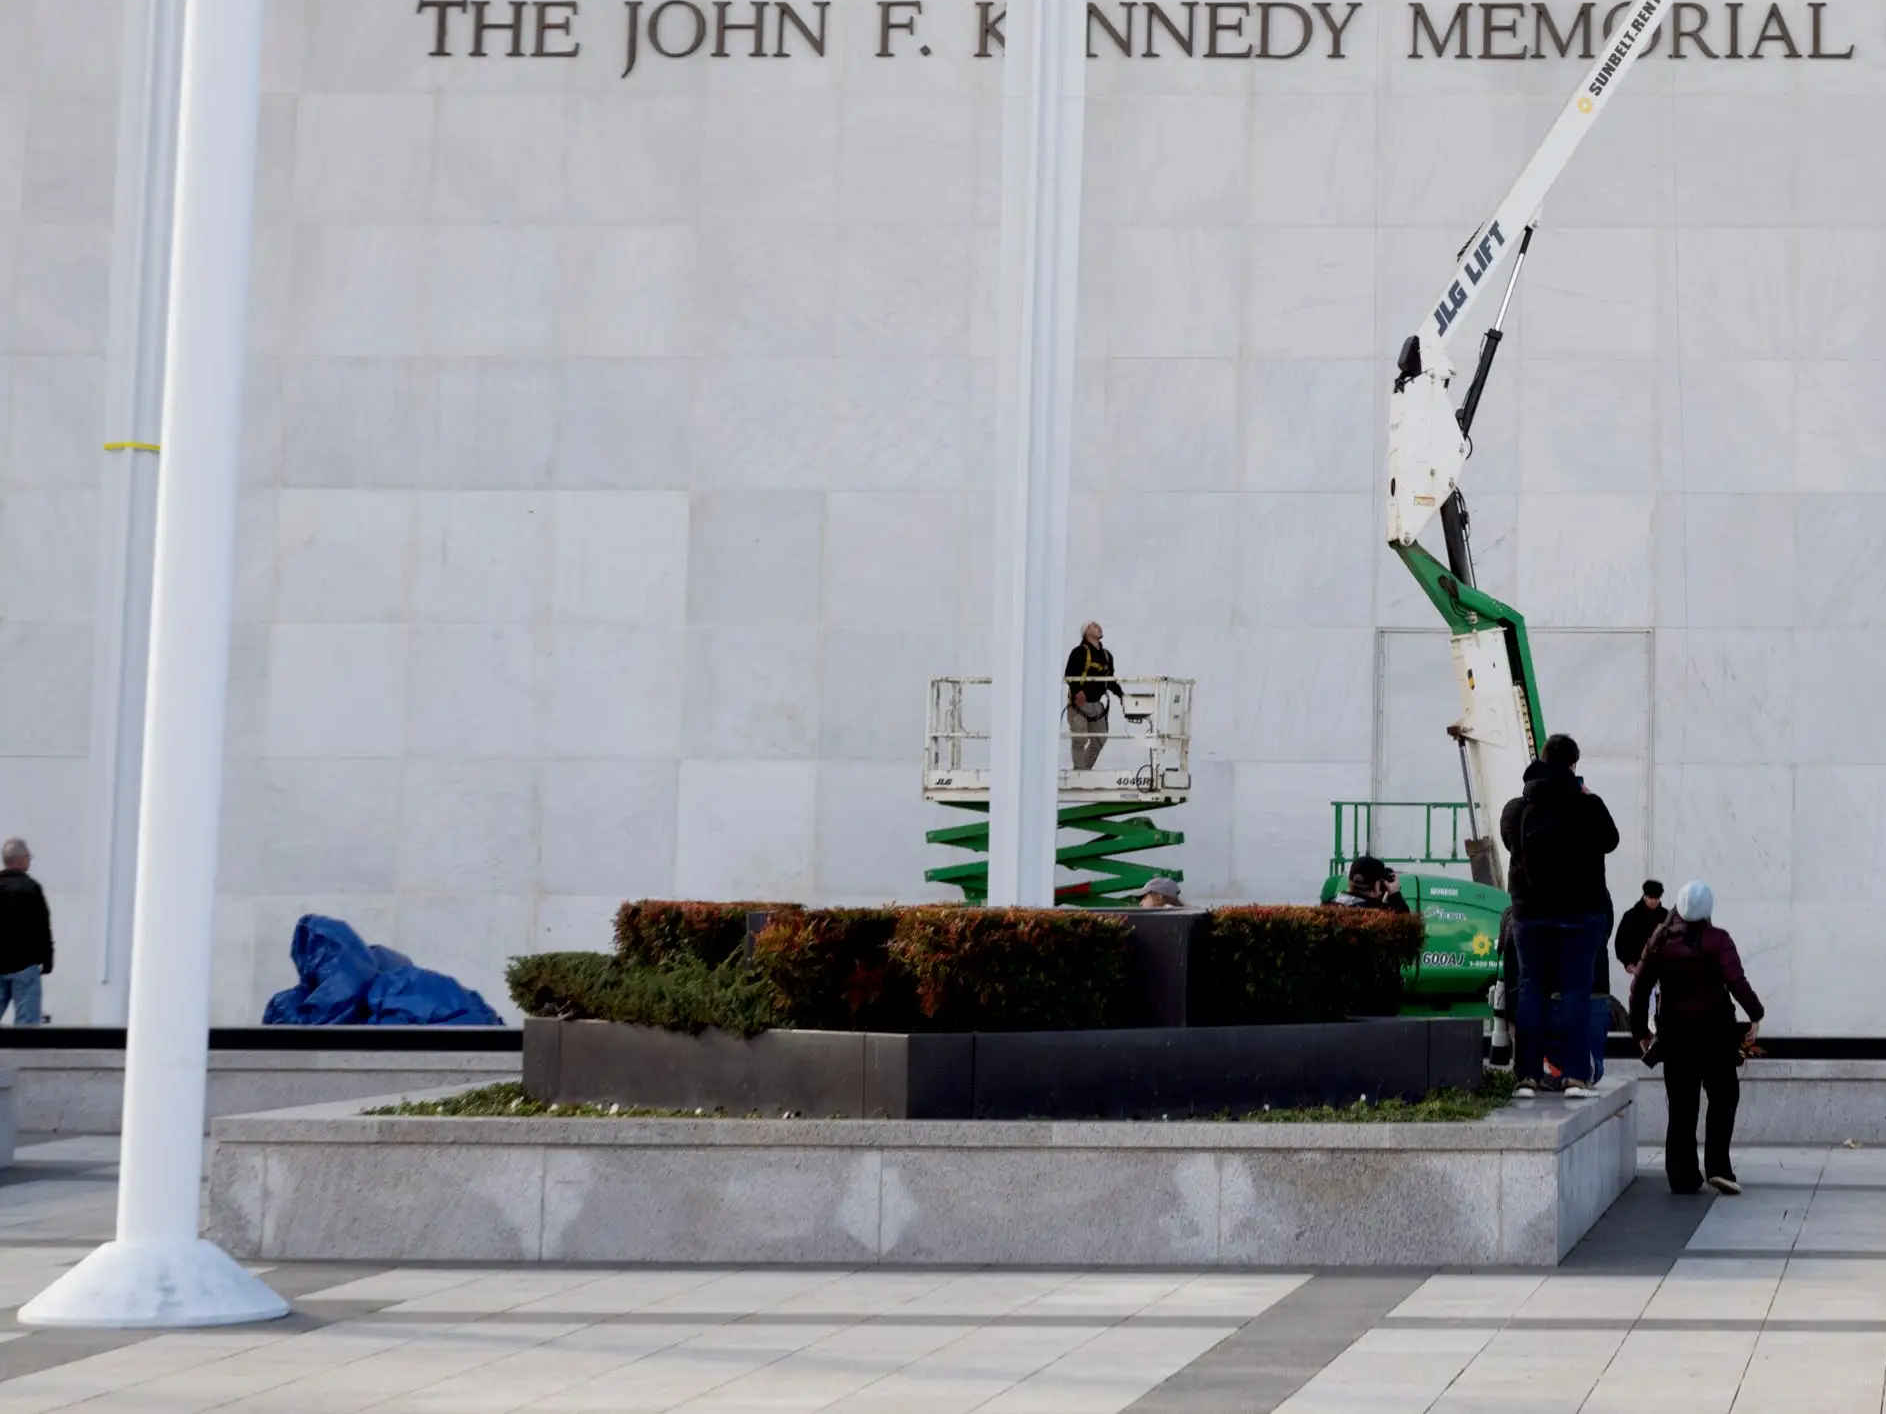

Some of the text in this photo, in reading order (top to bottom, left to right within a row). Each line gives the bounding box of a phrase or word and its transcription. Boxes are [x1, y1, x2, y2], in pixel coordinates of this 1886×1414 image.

[620, 0, 831, 79] JOHN
[875, 0, 932, 59] F.
[973, 0, 1363, 60] KNNEDY
[1588, 29, 1636, 97] SUNBELT
[1433, 220, 1506, 337] JLG LIFT
[1422, 951, 1465, 967] 600AJ
